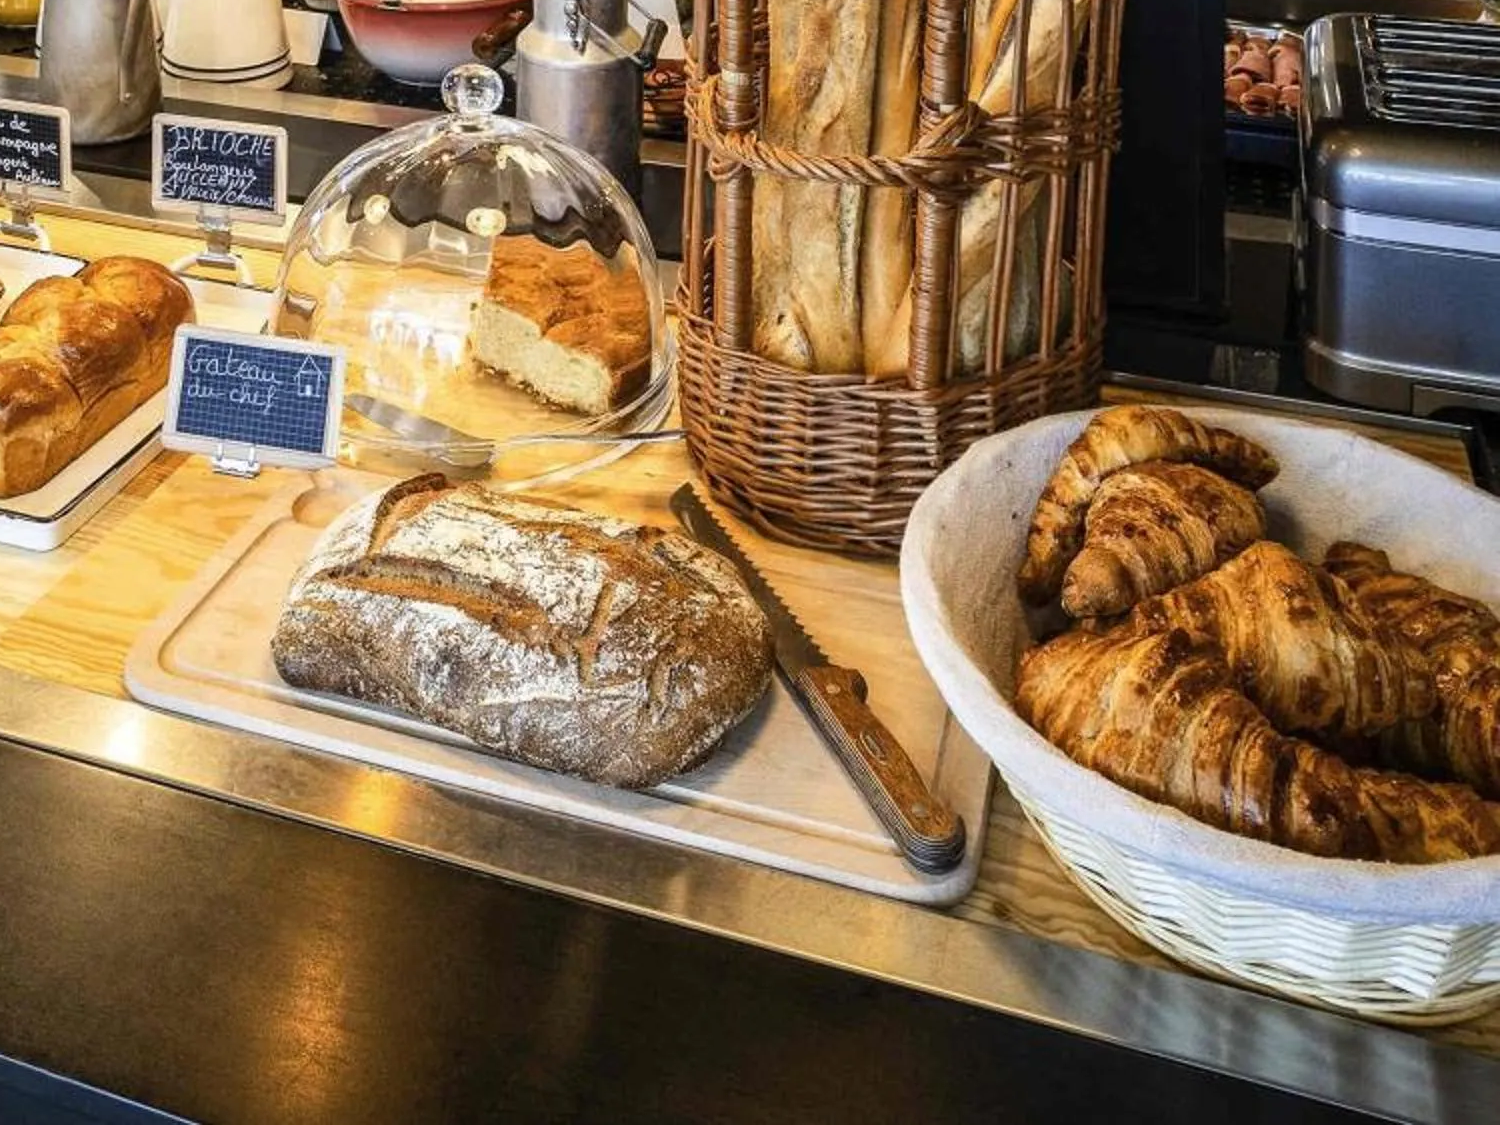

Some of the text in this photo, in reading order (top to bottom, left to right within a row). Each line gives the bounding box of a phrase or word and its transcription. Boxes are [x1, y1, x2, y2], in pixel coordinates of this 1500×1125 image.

[9, 114, 31, 133] de
[167, 124, 275, 160] BRIOCHE
[229, 381, 279, 416] chef
